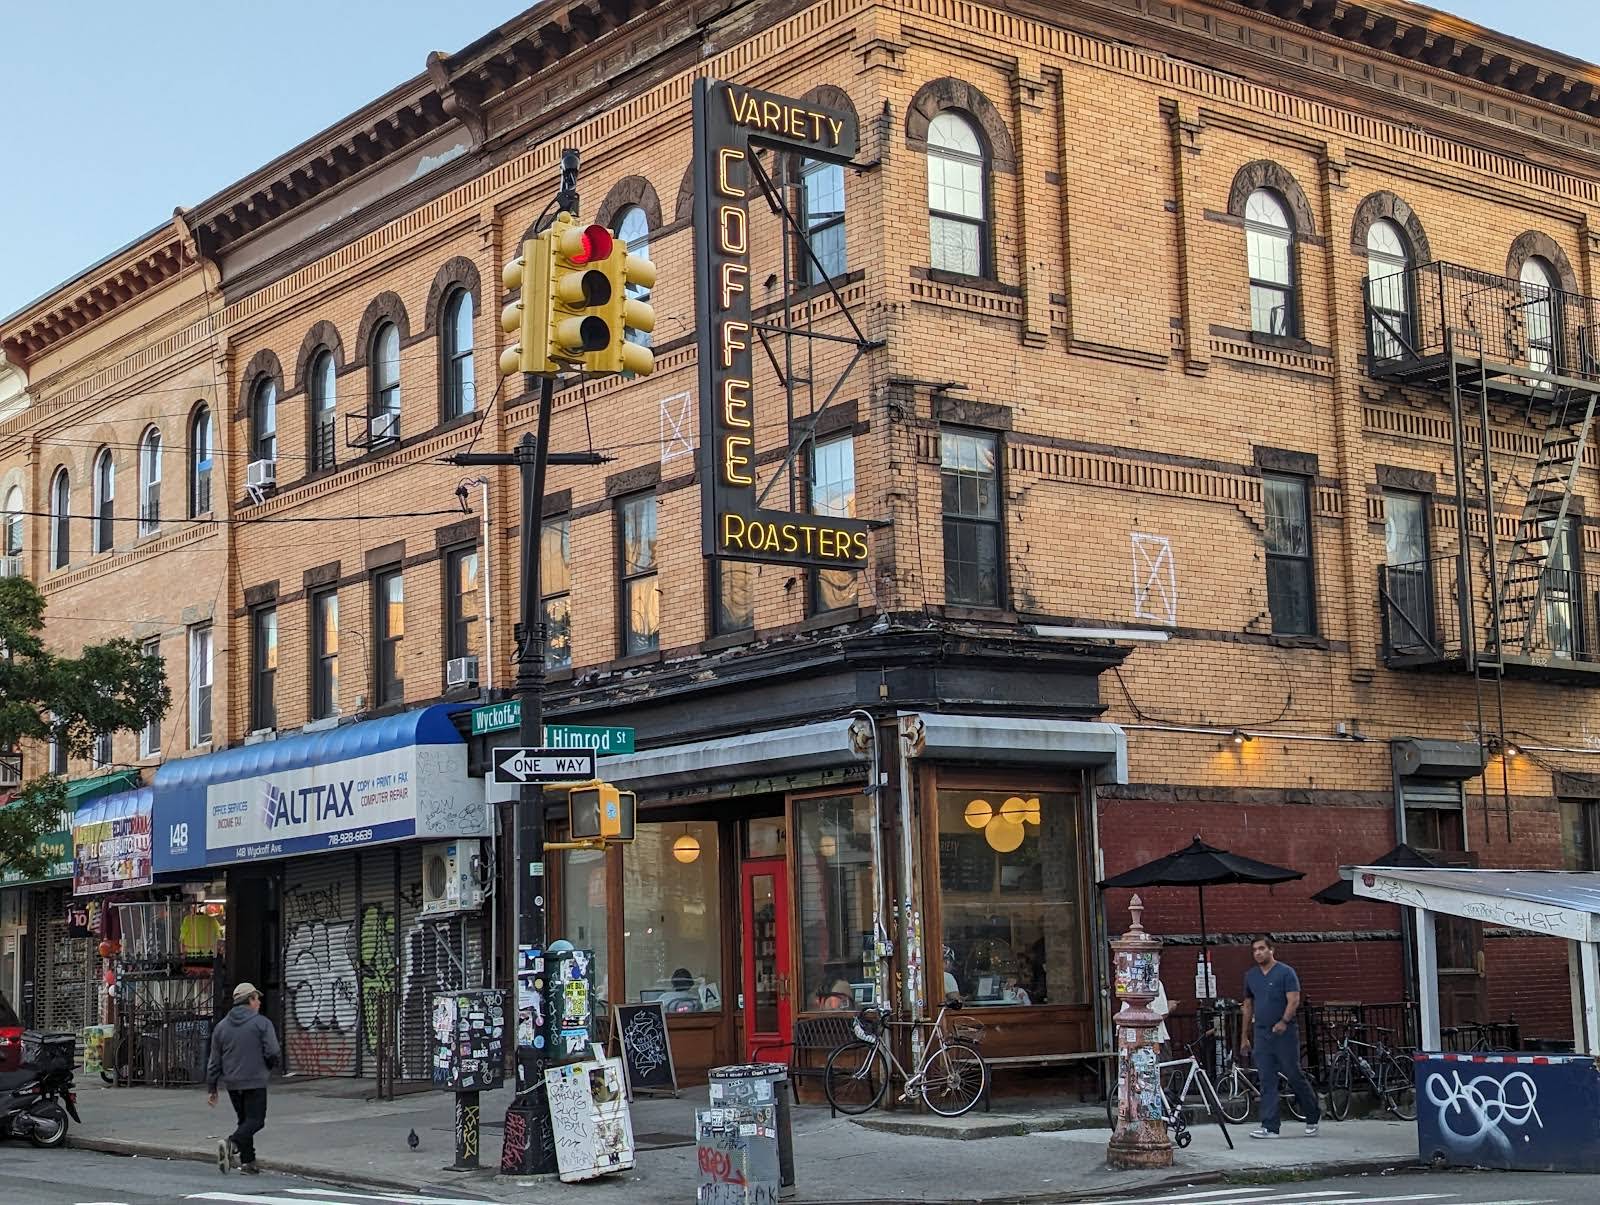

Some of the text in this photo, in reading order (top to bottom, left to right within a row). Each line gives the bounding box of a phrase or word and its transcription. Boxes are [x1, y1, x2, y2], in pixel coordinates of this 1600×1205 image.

[727, 87, 843, 145] VARIETY
[719, 148, 752, 485] COFFEE
[724, 514, 868, 560] ROASTERS
[476, 705, 512, 733] Wyckoff
[553, 728, 626, 750] Himrod St
[514, 758, 585, 772] ONE WAY
[357, 772, 408, 792] COPY PRINT FAX
[273, 780, 354, 828] ALTTAX
[360, 788, 408, 807] COMPUTER REPAIR
[213, 801, 248, 816] OFFICE SERVICES
[217, 817, 234, 829] INCOME
[170, 822, 188, 848] 148
[328, 829, 373, 846] 718-928-6639
[247, 845, 269, 858] Wyckoff
[270, 843, 282, 853] Ave
[74, 914, 87, 927] 10
[704, 988, 717, 1003] A
